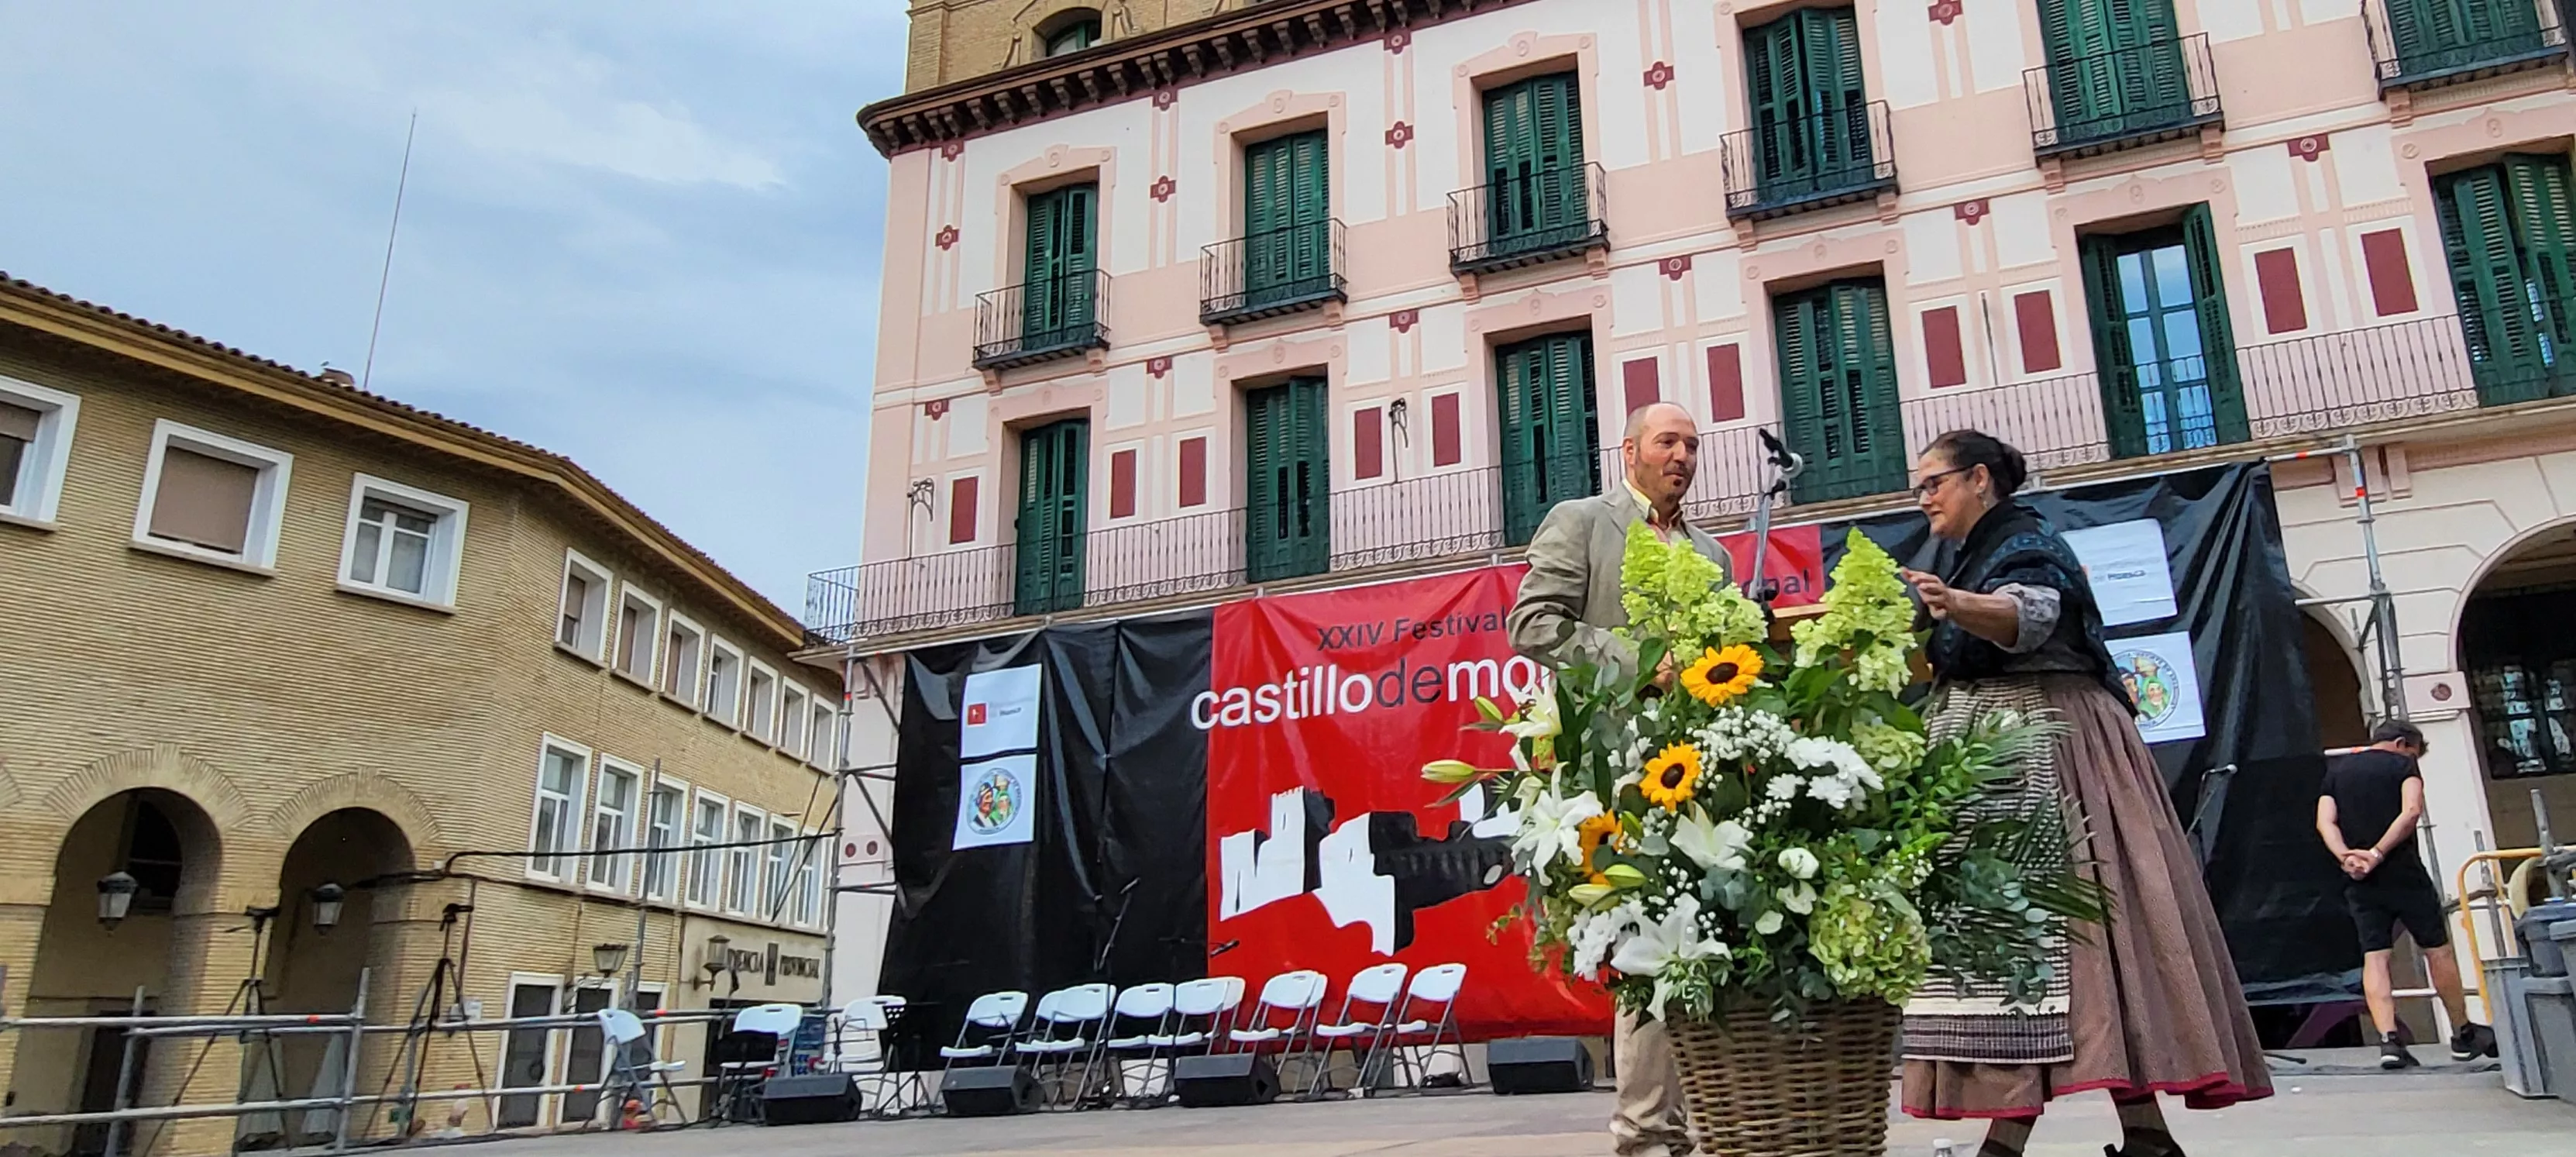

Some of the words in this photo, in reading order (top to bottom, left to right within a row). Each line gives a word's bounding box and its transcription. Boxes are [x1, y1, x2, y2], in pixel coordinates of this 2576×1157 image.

[1317, 622, 1384, 651] XXIV
[1394, 605, 1508, 642] Festival
[1191, 655, 1550, 730] castillodemo
